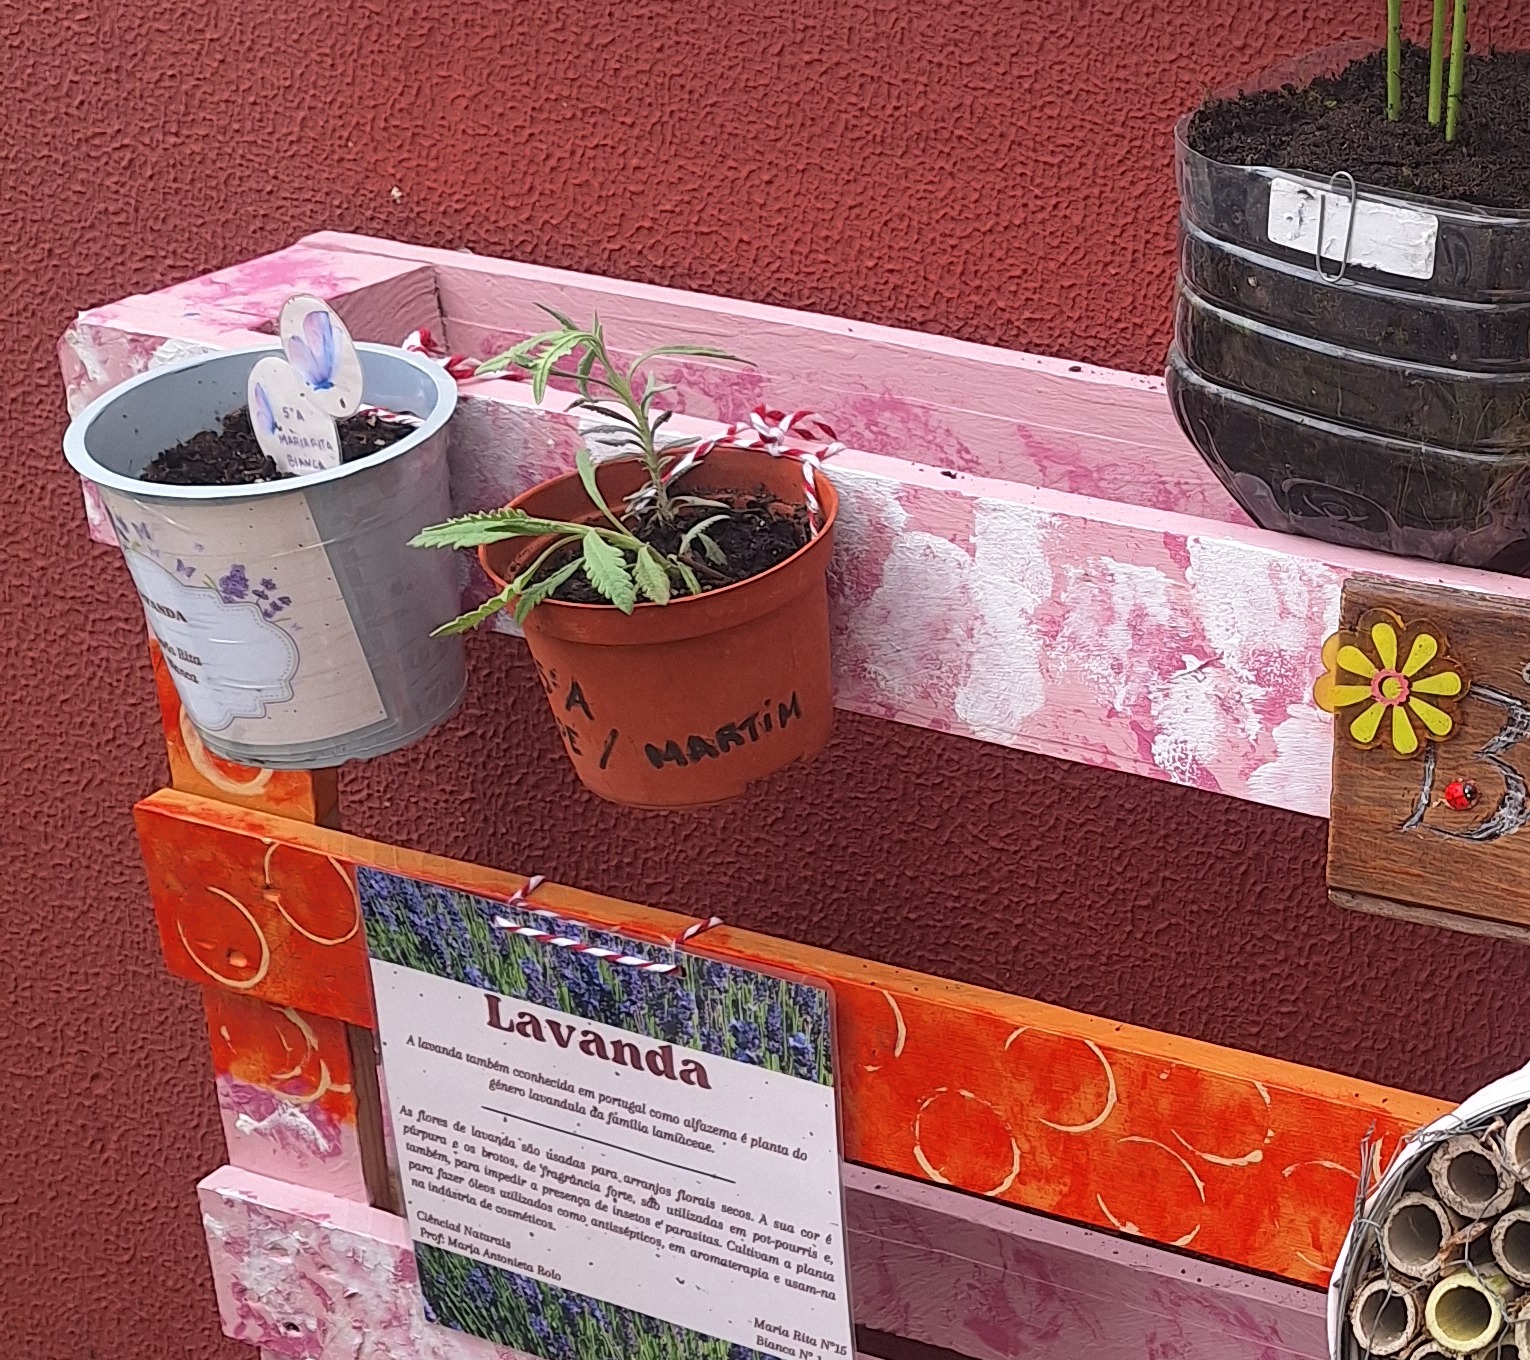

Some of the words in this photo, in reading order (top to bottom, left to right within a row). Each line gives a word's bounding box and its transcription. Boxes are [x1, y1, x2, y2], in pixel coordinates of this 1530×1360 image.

[484, 993, 713, 1090] Lavanda
[405, 1034, 415, 1046] A
[418, 1036, 463, 1060] lavanda
[465, 1053, 510, 1075] também
[578, 1087, 595, 1099] em
[598, 1092, 646, 1114] portugal
[649, 1108, 680, 1125] como
[684, 1117, 738, 1141] alfazema
[741, 1132, 748, 1144] é
[750, 1137, 789, 1156] planta
[792, 1147, 808, 1161] do
[528, 1087, 587, 1115] lavandula
[400, 1104, 413, 1117] As
[416, 1109, 448, 1127] flores
[453, 1120, 466, 1133] de
[471, 1125, 516, 1149] lavanda
[521, 1143, 540, 1156] são
[591, 1164, 618, 1180] para
[623, 1174, 671, 1196] arranjos
[675, 1189, 716, 1209] florais
[721, 1204, 754, 1222] secos.
[758, 1213, 768, 1226] A
[773, 1220, 795, 1234] sua
[800, 1228, 821, 1241] cor
[825, 1233, 832, 1245] é
[403, 1124, 447, 1145] púrpura
[452, 1140, 459, 1148] e
[464, 1143, 476, 1154] os
[481, 1146, 518, 1169] brotos,
[523, 1160, 536, 1172] de
[605, 1185, 636, 1204] forte,
[666, 1206, 724, 1230] utilizadas
[729, 1225, 747, 1237] em
[752, 1232, 818, 1259] pot-pourris
[823, 1254, 834, 1265] e,
[405, 1142, 451, 1165] também,
[454, 1158, 480, 1173] para
[484, 1165, 527, 1187] impedir
[530, 1181, 539, 1191] a
[594, 1199, 609, 1213] de
[612, 1205, 651, 1225] insetos
[665, 1223, 722, 1248] parasitas.
[726, 1240, 780, 1266] Cultivam
[783, 1259, 792, 1269] a
[796, 1263, 835, 1282] planta
[411, 1177, 425, 1189] na
[428, 1181, 477, 1206] indústria
[480, 1198, 493, 1211] de
[495, 1205, 556, 1232] cosméticos.
[408, 1160, 433, 1176] para
[436, 1168, 465, 1184] fazer
[468, 1178, 496, 1195] óleos
[500, 1190, 553, 1213] utilizados
[557, 1207, 587, 1223] como
[591, 1216, 665, 1250] antissépticos,
[669, 1242, 686, 1255] em
[690, 1249, 770, 1281] aromaterapia
[773, 1274, 781, 1284] e
[785, 1277, 837, 1301] usam-na
[416, 1210, 461, 1233] Ciências
[463, 1224, 511, 1249] Naturais
[447, 1235, 480, 1255] Maria
[482, 1248, 535, 1273] Antonieta
[536, 1264, 562, 1281] Rolo
[754, 1317, 790, 1338] Maria
[793, 1329, 817, 1347] Rita
[756, 1334, 796, 1357] Bianca
